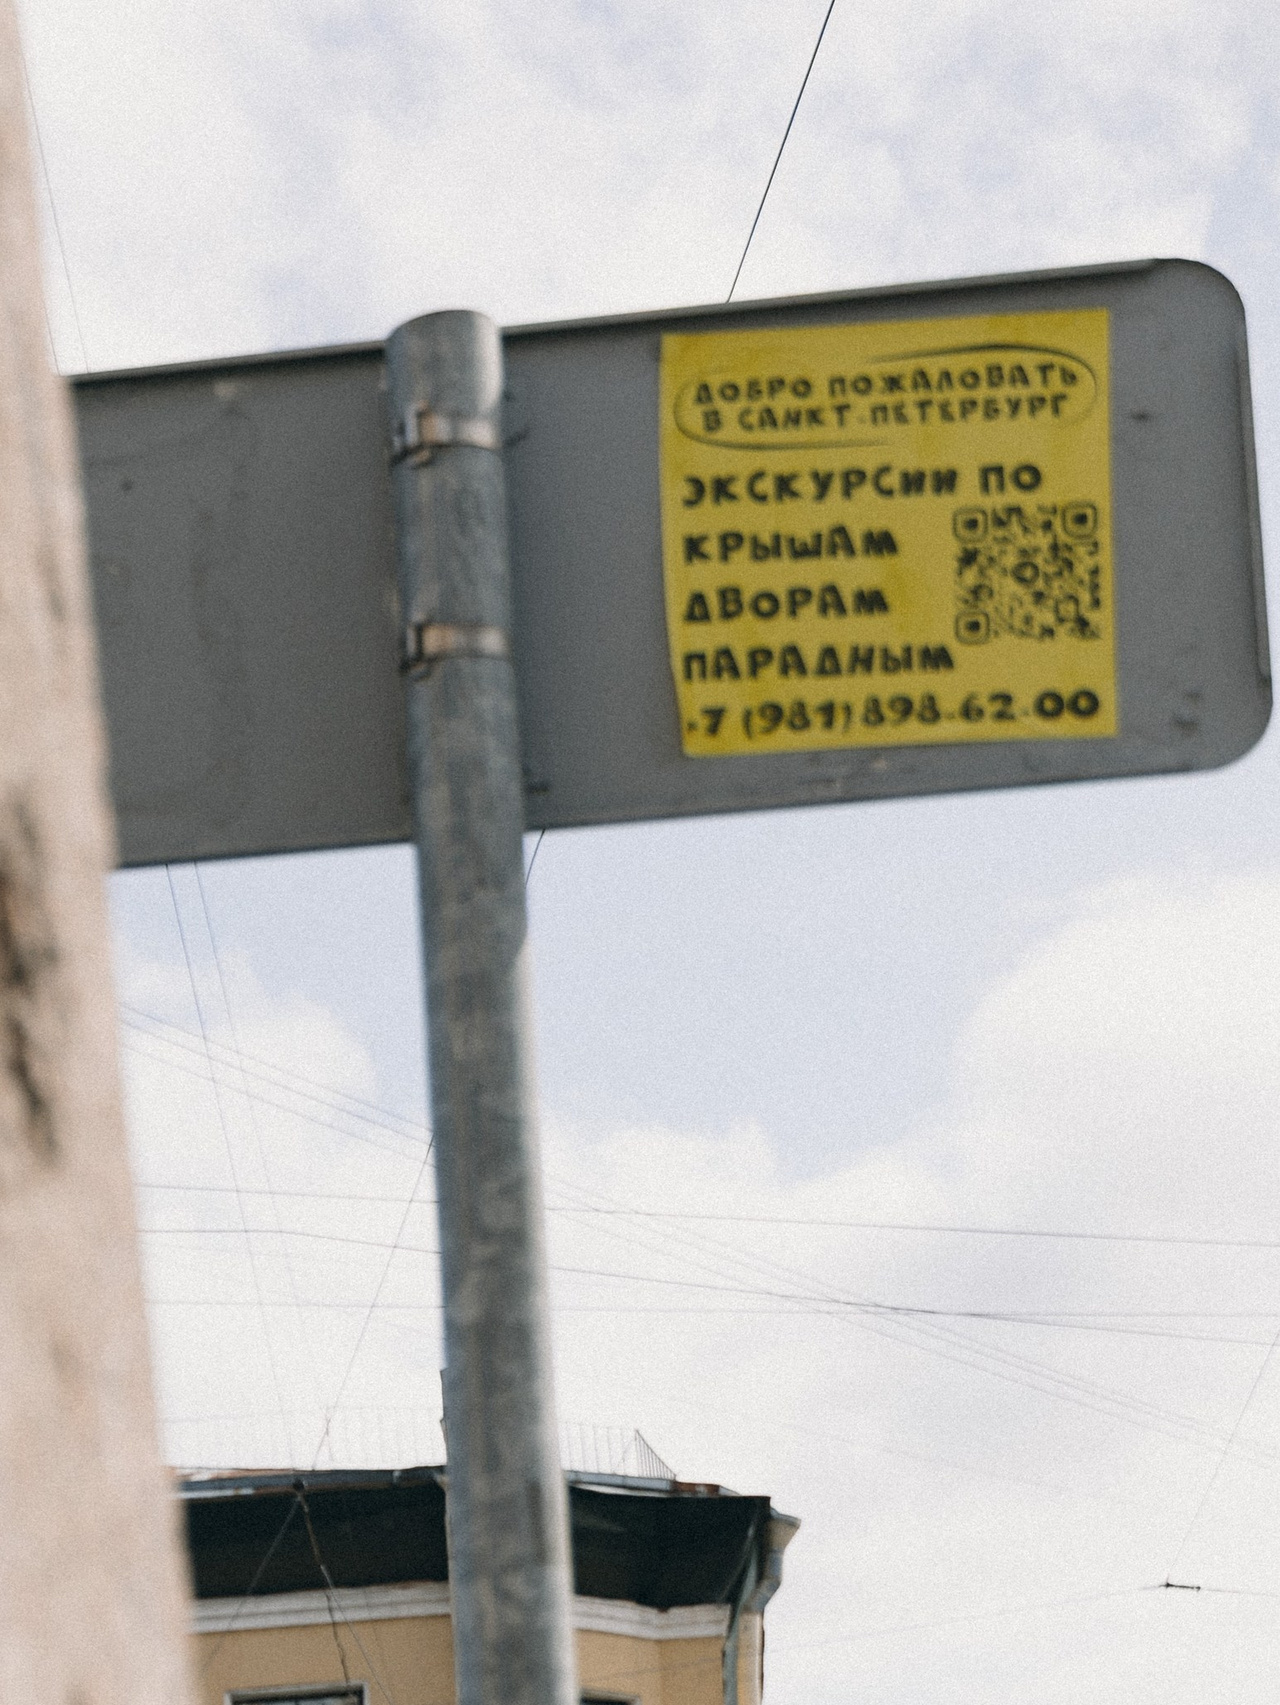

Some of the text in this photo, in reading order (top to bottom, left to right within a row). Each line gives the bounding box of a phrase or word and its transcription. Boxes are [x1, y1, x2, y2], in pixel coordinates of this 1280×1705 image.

[695, 362, 1078, 404] ДОБРО ПОЖАЛОВАТЬ
[702, 408, 723, 433] В
[683, 463, 1043, 507] ЭКСКУРСИИ ПО
[683, 524, 899, 564] КРЫШАМ
[683, 582, 890, 624] ДВОРАМ
[683, 643, 955, 682] ПАРАДНЫМ
